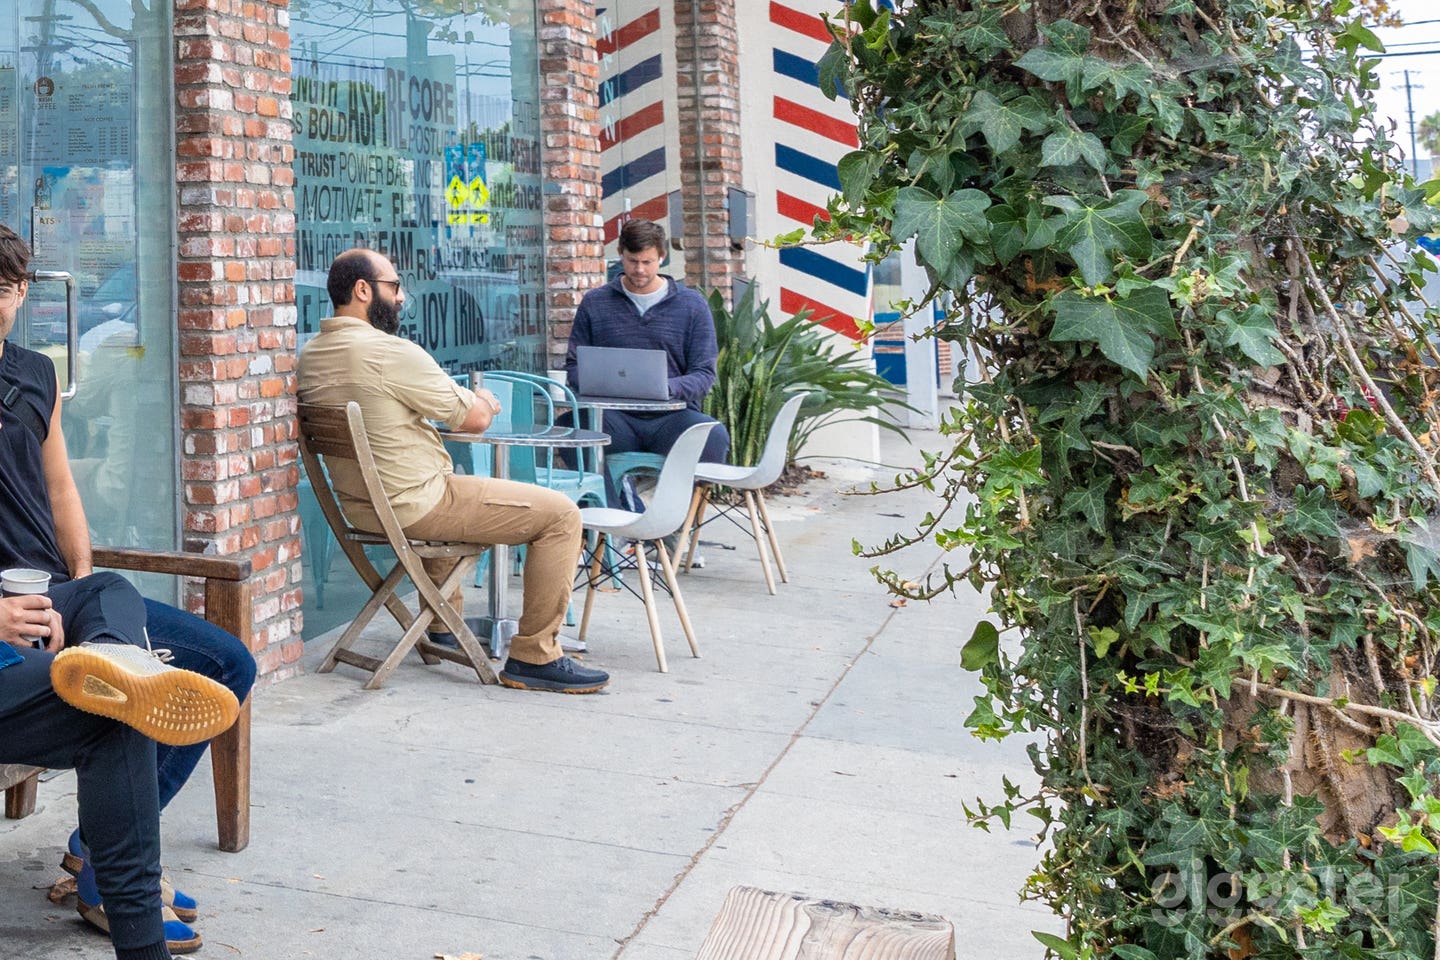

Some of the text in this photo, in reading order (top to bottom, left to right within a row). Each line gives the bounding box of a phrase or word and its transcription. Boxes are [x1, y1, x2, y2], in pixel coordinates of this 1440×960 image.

[409, 74, 454, 125] CORE
[308, 107, 347, 143] BOLD
[300, 152, 337, 178] TRUST
[339, 151, 384, 186] POWER
[302, 185, 383, 223] MOTIVATE
[418, 292, 449, 351] JOY
